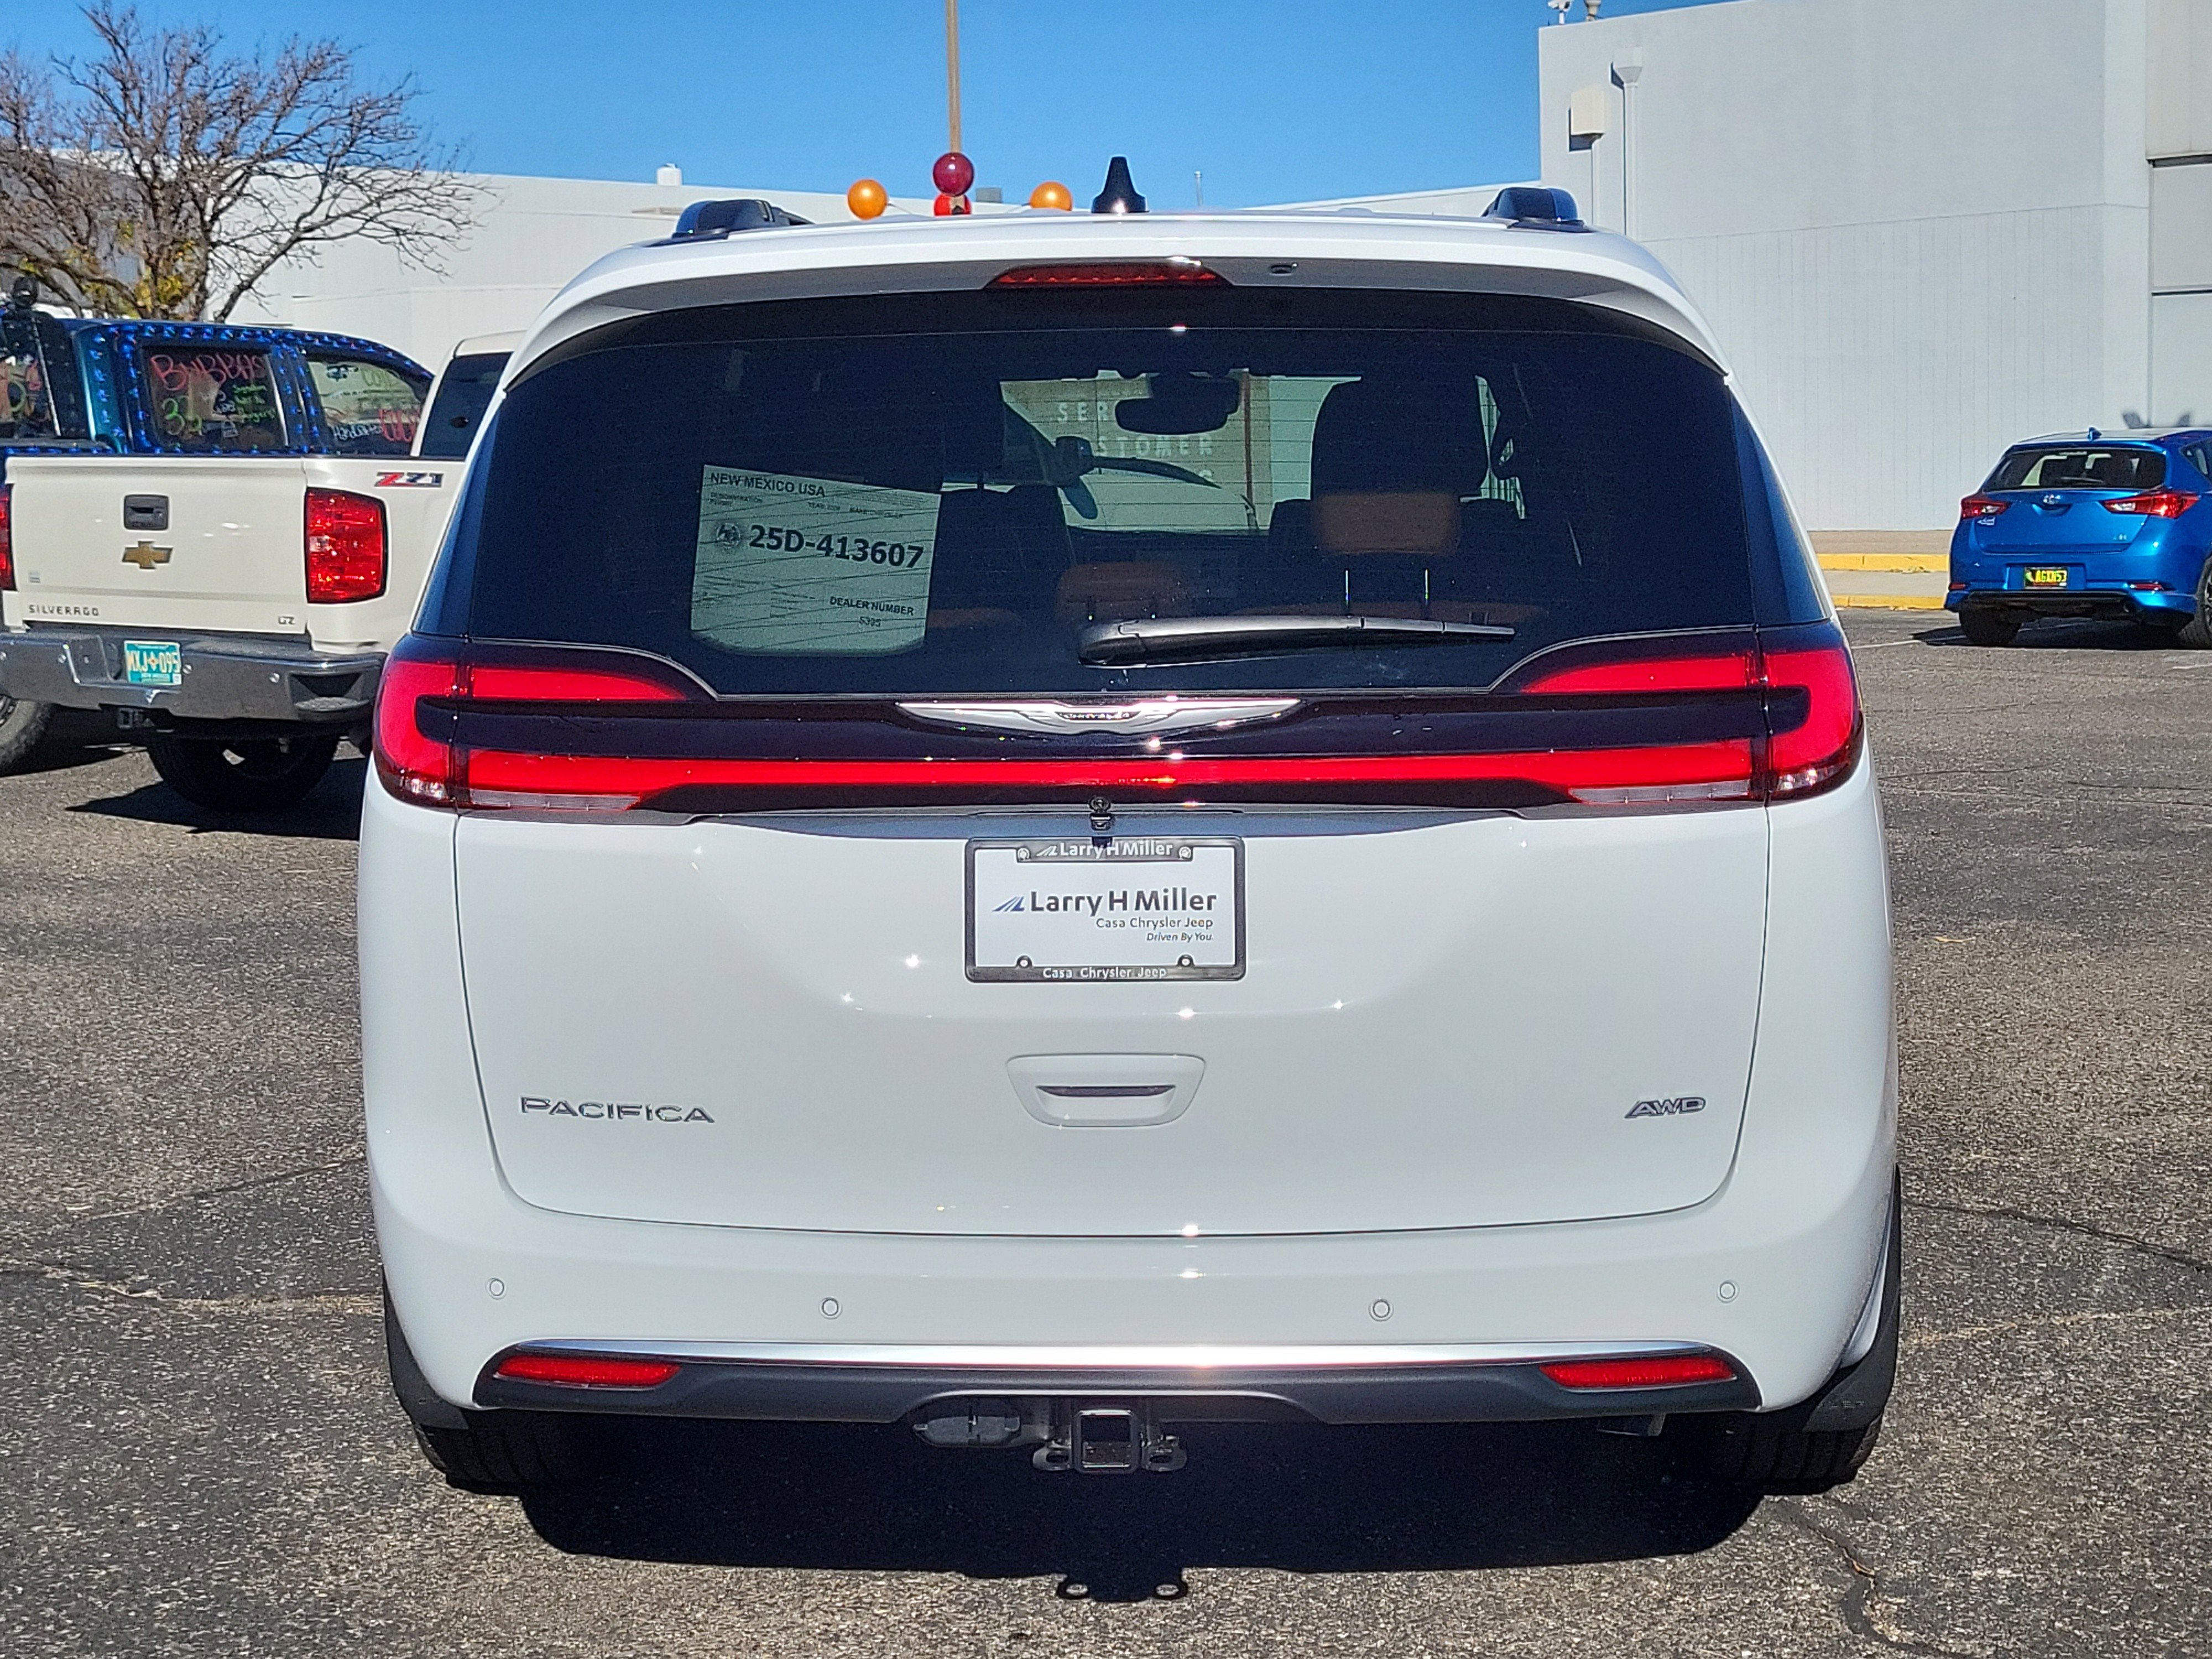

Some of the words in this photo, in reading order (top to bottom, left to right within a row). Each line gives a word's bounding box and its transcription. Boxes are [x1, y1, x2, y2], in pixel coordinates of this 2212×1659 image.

[1057, 401, 1108, 422] SER
[1098, 435, 1213, 457] STOMER
[711, 472, 745, 486] NEW
[745, 477, 795, 493] MEXICO
[799, 483, 826, 498] USA
[749, 524, 925, 568] 25D-413607
[830, 596, 869, 609] DEALER
[870, 602, 915, 616] NUMBER
[1060, 842, 1105, 859] Larry
[1107, 843, 1120, 856] H
[1122, 839, 1173, 856] Miller
[1031, 891, 1103, 917] Larry
[1109, 891, 1128, 911] H
[1135, 888, 1217, 911] Miller
[1095, 918, 1125, 928] Casa
[1130, 916, 1181, 930] Chrysler
[1184, 917, 1213, 930] Jeep
[1146, 932, 1178, 941] Driven
[1181, 933, 1192, 942] By
[1043, 968, 1073, 979] Casa
[1080, 967, 1132, 980] Chrysler
[1137, 967, 1167, 979] Jeep
[520, 1097, 715, 1124] PACIFICA
[1624, 1097, 1706, 1119] AWD
